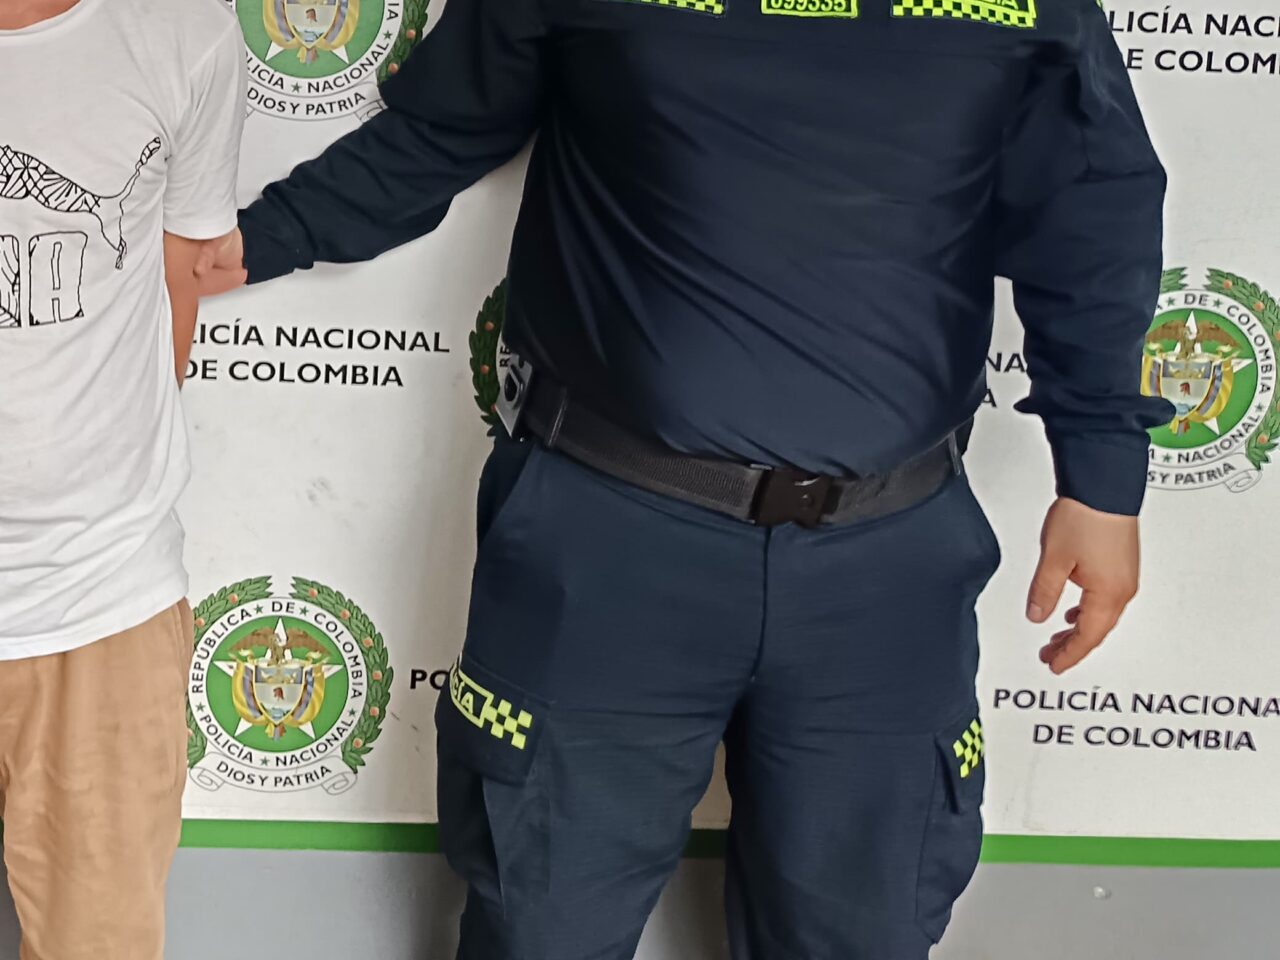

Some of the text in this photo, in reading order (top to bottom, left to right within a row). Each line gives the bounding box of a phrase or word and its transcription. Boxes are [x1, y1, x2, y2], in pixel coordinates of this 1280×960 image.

[1109, 5, 1193, 35] LICÍA
[246, 44, 390, 93] LICÍA NACIONAL
[1154, 49, 1280, 75] COLOM
[246, 87, 367, 115] DIOS Y PATRIA
[193, 318, 451, 354] ICÍA NACIONAL
[1184, 293, 1273, 394] DE COLOMBIA
[228, 360, 404, 387] COLOMBIA
[1178, 416, 1260, 464] NACIONAL
[1175, 462, 1235, 484] PATRIA
[271, 601, 295, 613] DE
[314, 613, 363, 699] COLOMBIA
[993, 686, 1280, 718] POLICÍA NACIONA
[199, 715, 354, 767] POLICÍA NACIONAL
[1033, 724, 1257, 752] DE COLOMBIA
[216, 761, 332, 787] DIOS Y PATRIA
